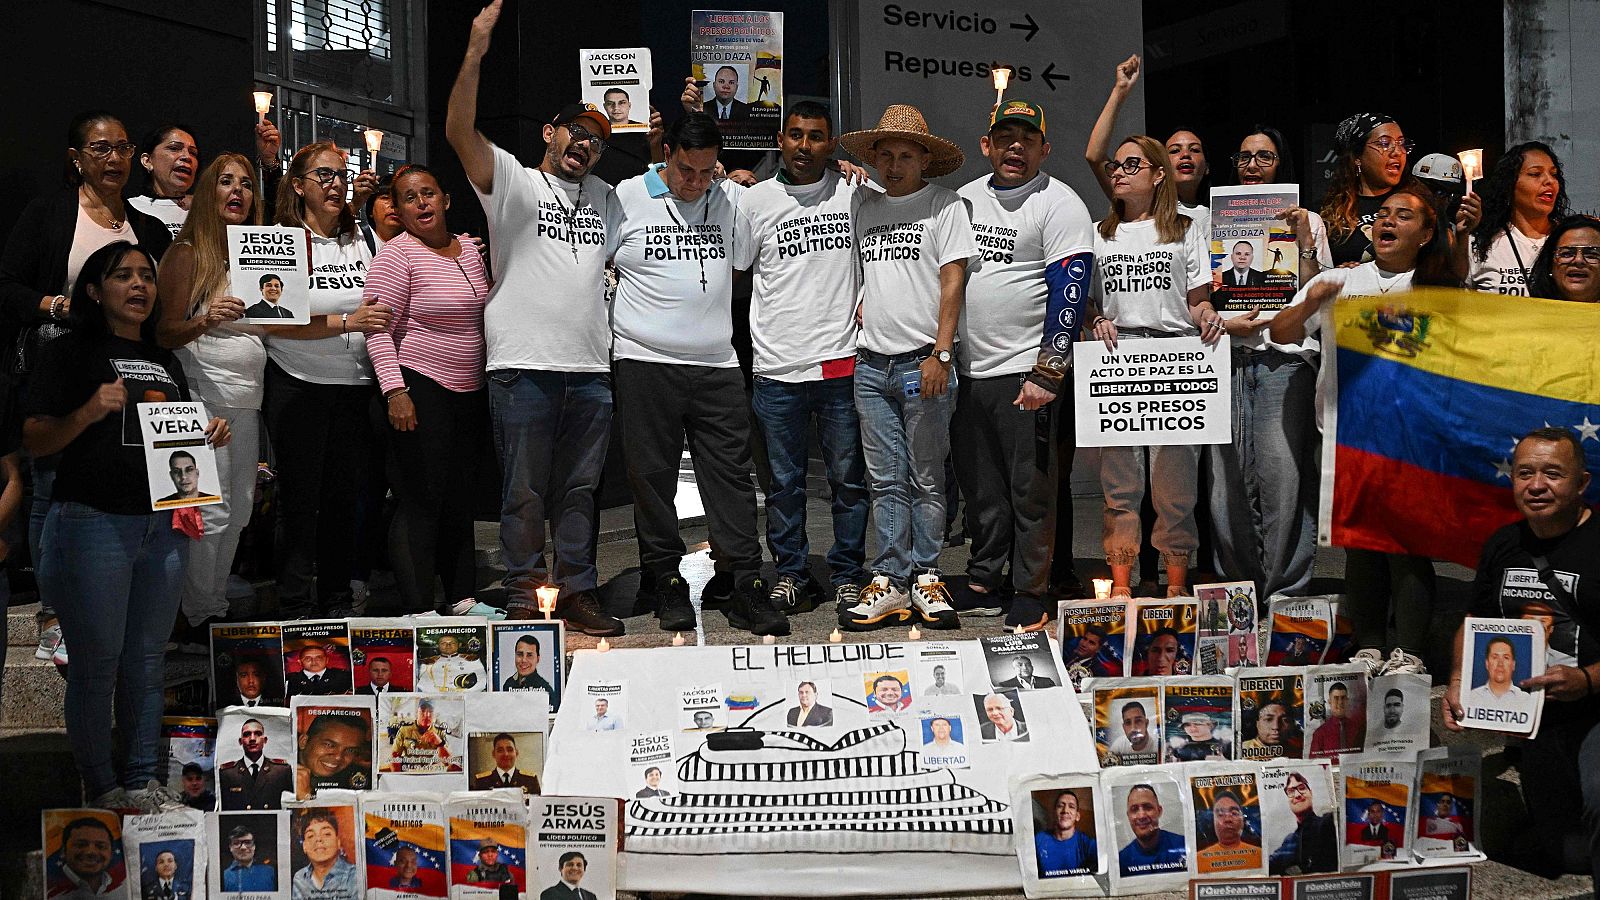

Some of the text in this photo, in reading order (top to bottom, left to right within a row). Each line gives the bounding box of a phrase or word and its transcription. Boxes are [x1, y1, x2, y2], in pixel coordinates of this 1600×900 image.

[884, 4, 996, 34] Servicio
[700, 26, 732, 36] PRESOS
[725, 52, 752, 60] DAZA
[590, 64, 638, 75] VERA
[539, 210, 603, 229] LOS PRESOS
[776, 217, 811, 232] LIBEREN
[821, 212, 850, 222] TODOS
[777, 222, 850, 244] LOS PRESOS
[864, 225, 889, 237] LIBEREN
[898, 223, 924, 232] TODOS
[994, 227, 1018, 237] TODOS
[1212, 230, 1238, 239] JUSTO
[240, 232, 294, 245] JESÚS
[646, 234, 723, 245] LOS PRESOS
[880, 233, 922, 245] PRESOS
[975, 234, 1015, 251] PRESOS
[240, 245, 295, 256] ARMAS
[644, 246, 726, 260] POLÍTICOS
[778, 236, 851, 260] POLÍTICOS
[1102, 254, 1134, 266] LIBEREN
[1144, 251, 1173, 261] TODOS
[1103, 261, 1170, 278] LOS PRESOS
[309, 274, 364, 289] JESÚS
[1105, 276, 1171, 295] POLÍTICOS
[1500, 276, 1525, 284] LOS
[1102, 352, 1204, 365] UN VERDADERO
[118, 363, 150, 371] LIBERTAD
[1090, 364, 1214, 378] ACTO DE PAZ ES LA
[156, 375, 172, 383] VERA
[1091, 380, 1216, 394] LIBERTAD DE TODOS
[148, 406, 197, 415] JACKSON
[1098, 400, 1206, 414] LOS PRESOS
[150, 420, 204, 434] VERA
[1100, 414, 1205, 432] POLÍTICOS
[1503, 589, 1542, 599] RICARDO
[1065, 606, 1125, 616] ROSMEL MENDEZ
[1143, 608, 1192, 620] LIBEREN A
[1068, 615, 1121, 624] DESAPARECIDO
[220, 626, 276, 636] LIBERTAD
[354, 630, 407, 638] LIBERTAD
[1472, 624, 1505, 632] RICARDO
[991, 644, 1039, 652] CAMACARO
[733, 647, 765, 670] EL
[1240, 678, 1302, 691] LIBEREN A
[1314, 675, 1358, 683] DESAPARECIDO
[1173, 687, 1227, 696] LIBERTAD
[683, 696, 718, 705] VERA
[1467, 708, 1528, 724] LIBERTAD
[631, 735, 669, 747] JESÚS
[632, 743, 670, 755] ARMAS
[1242, 746, 1283, 757] RODOLFO
[924, 756, 966, 765] LIBERTAD
[542, 802, 605, 817] JESÚS
[542, 819, 605, 829] ARMAS
[1200, 885, 1276, 896] #QueSeanTodos
[1306, 881, 1361, 892] #QueSeanTodos
